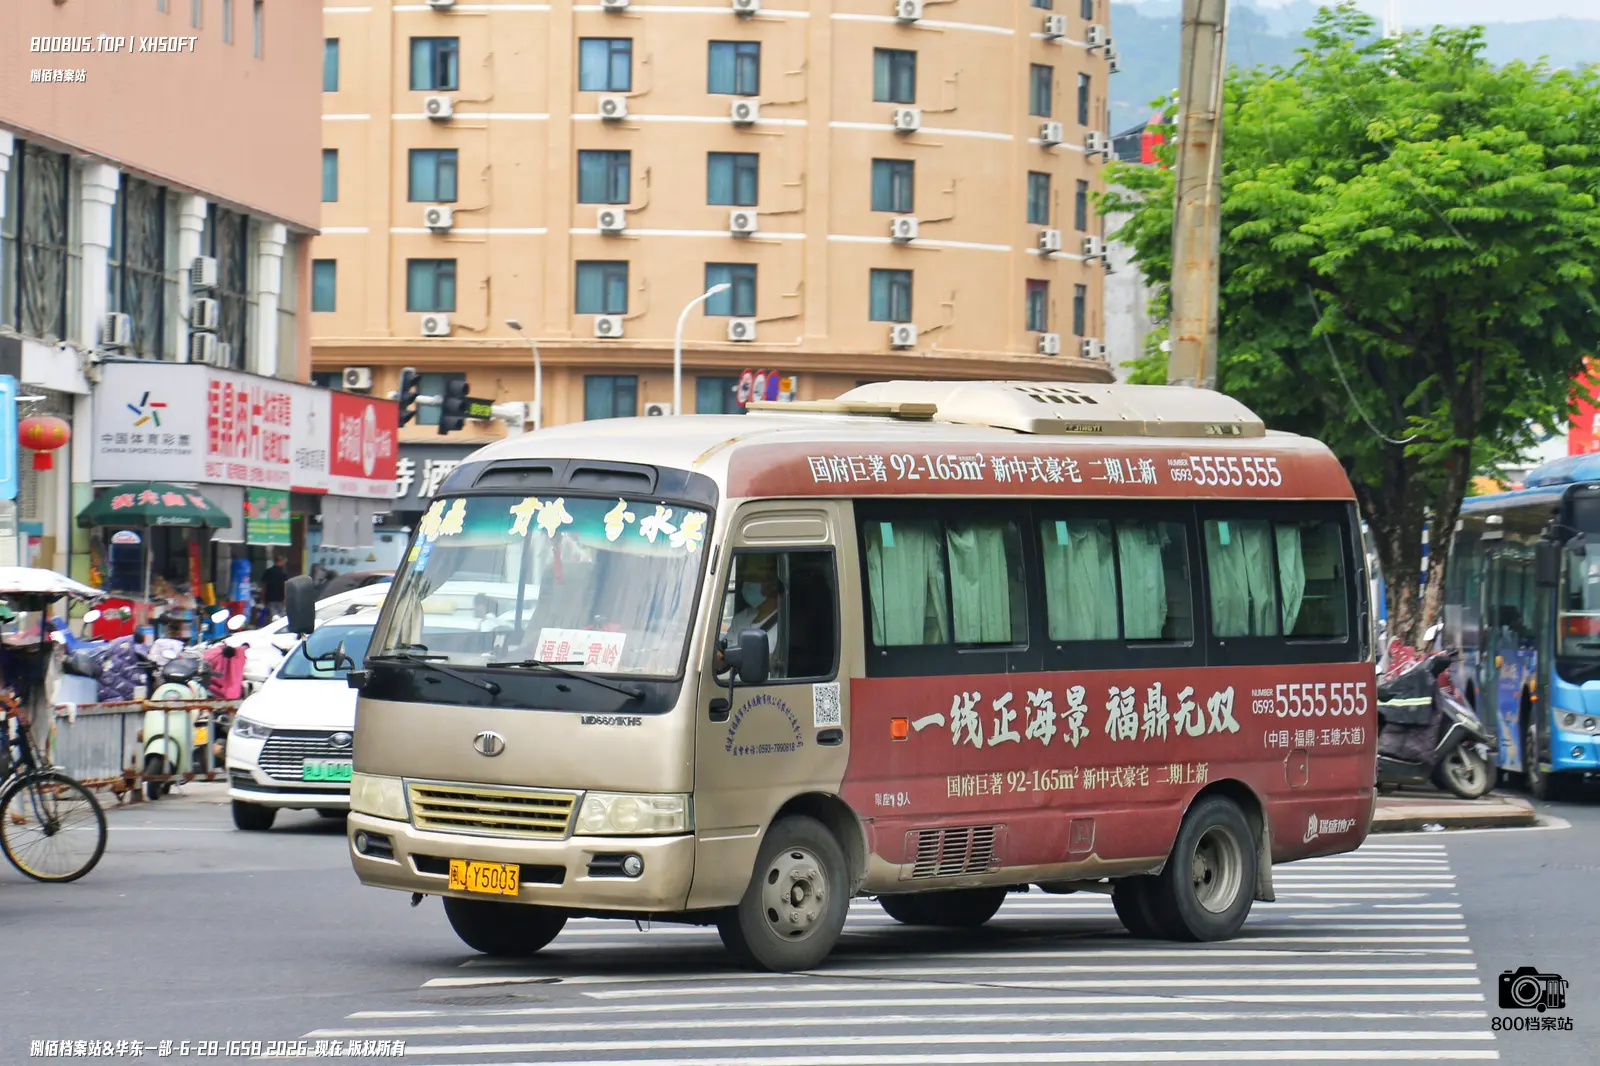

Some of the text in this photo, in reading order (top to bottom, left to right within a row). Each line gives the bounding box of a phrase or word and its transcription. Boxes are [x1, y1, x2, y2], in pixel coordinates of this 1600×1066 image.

[808, 455, 887, 483] 国府巨著
[991, 456, 1082, 484] 新中式豪宅
[1089, 457, 1157, 485] 二期上新
[1168, 459, 1189, 467] NUMBER
[1170, 468, 1192, 482] 0593
[1252, 689, 1273, 697] NUMBER
[1252, 700, 1274, 714] 0593
[912, 681, 1240, 748] 一线正海景 福鼎无双
[947, 774, 1003, 798] 国府巨著
[1082, 766, 1149, 790] 新中式豪宅
[1156, 762, 1208, 785] 二期上新
